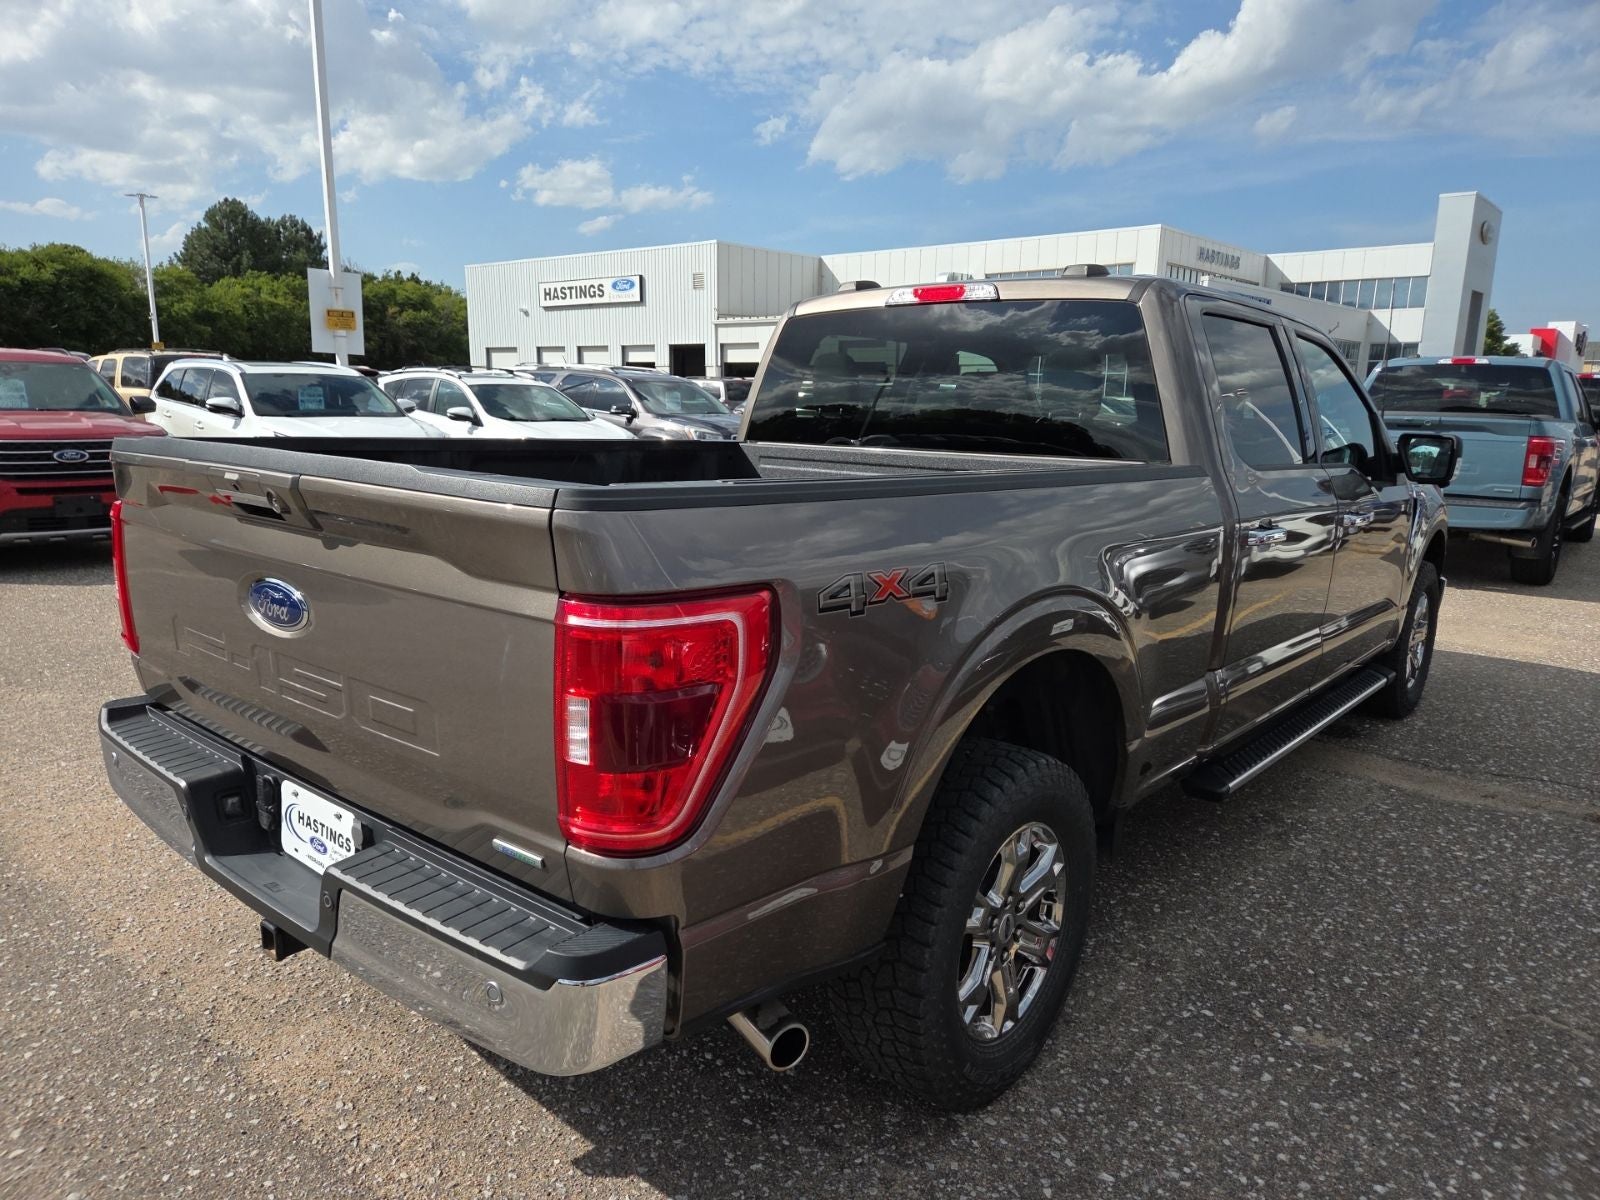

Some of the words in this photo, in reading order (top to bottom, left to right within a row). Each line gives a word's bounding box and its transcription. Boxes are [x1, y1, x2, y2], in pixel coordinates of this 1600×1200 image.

[1199, 247, 1240, 270] HASTINGS
[543, 284, 605, 301] HASTINGS
[258, 587, 290, 621] Ford
[298, 810, 352, 853] HASTINGS
